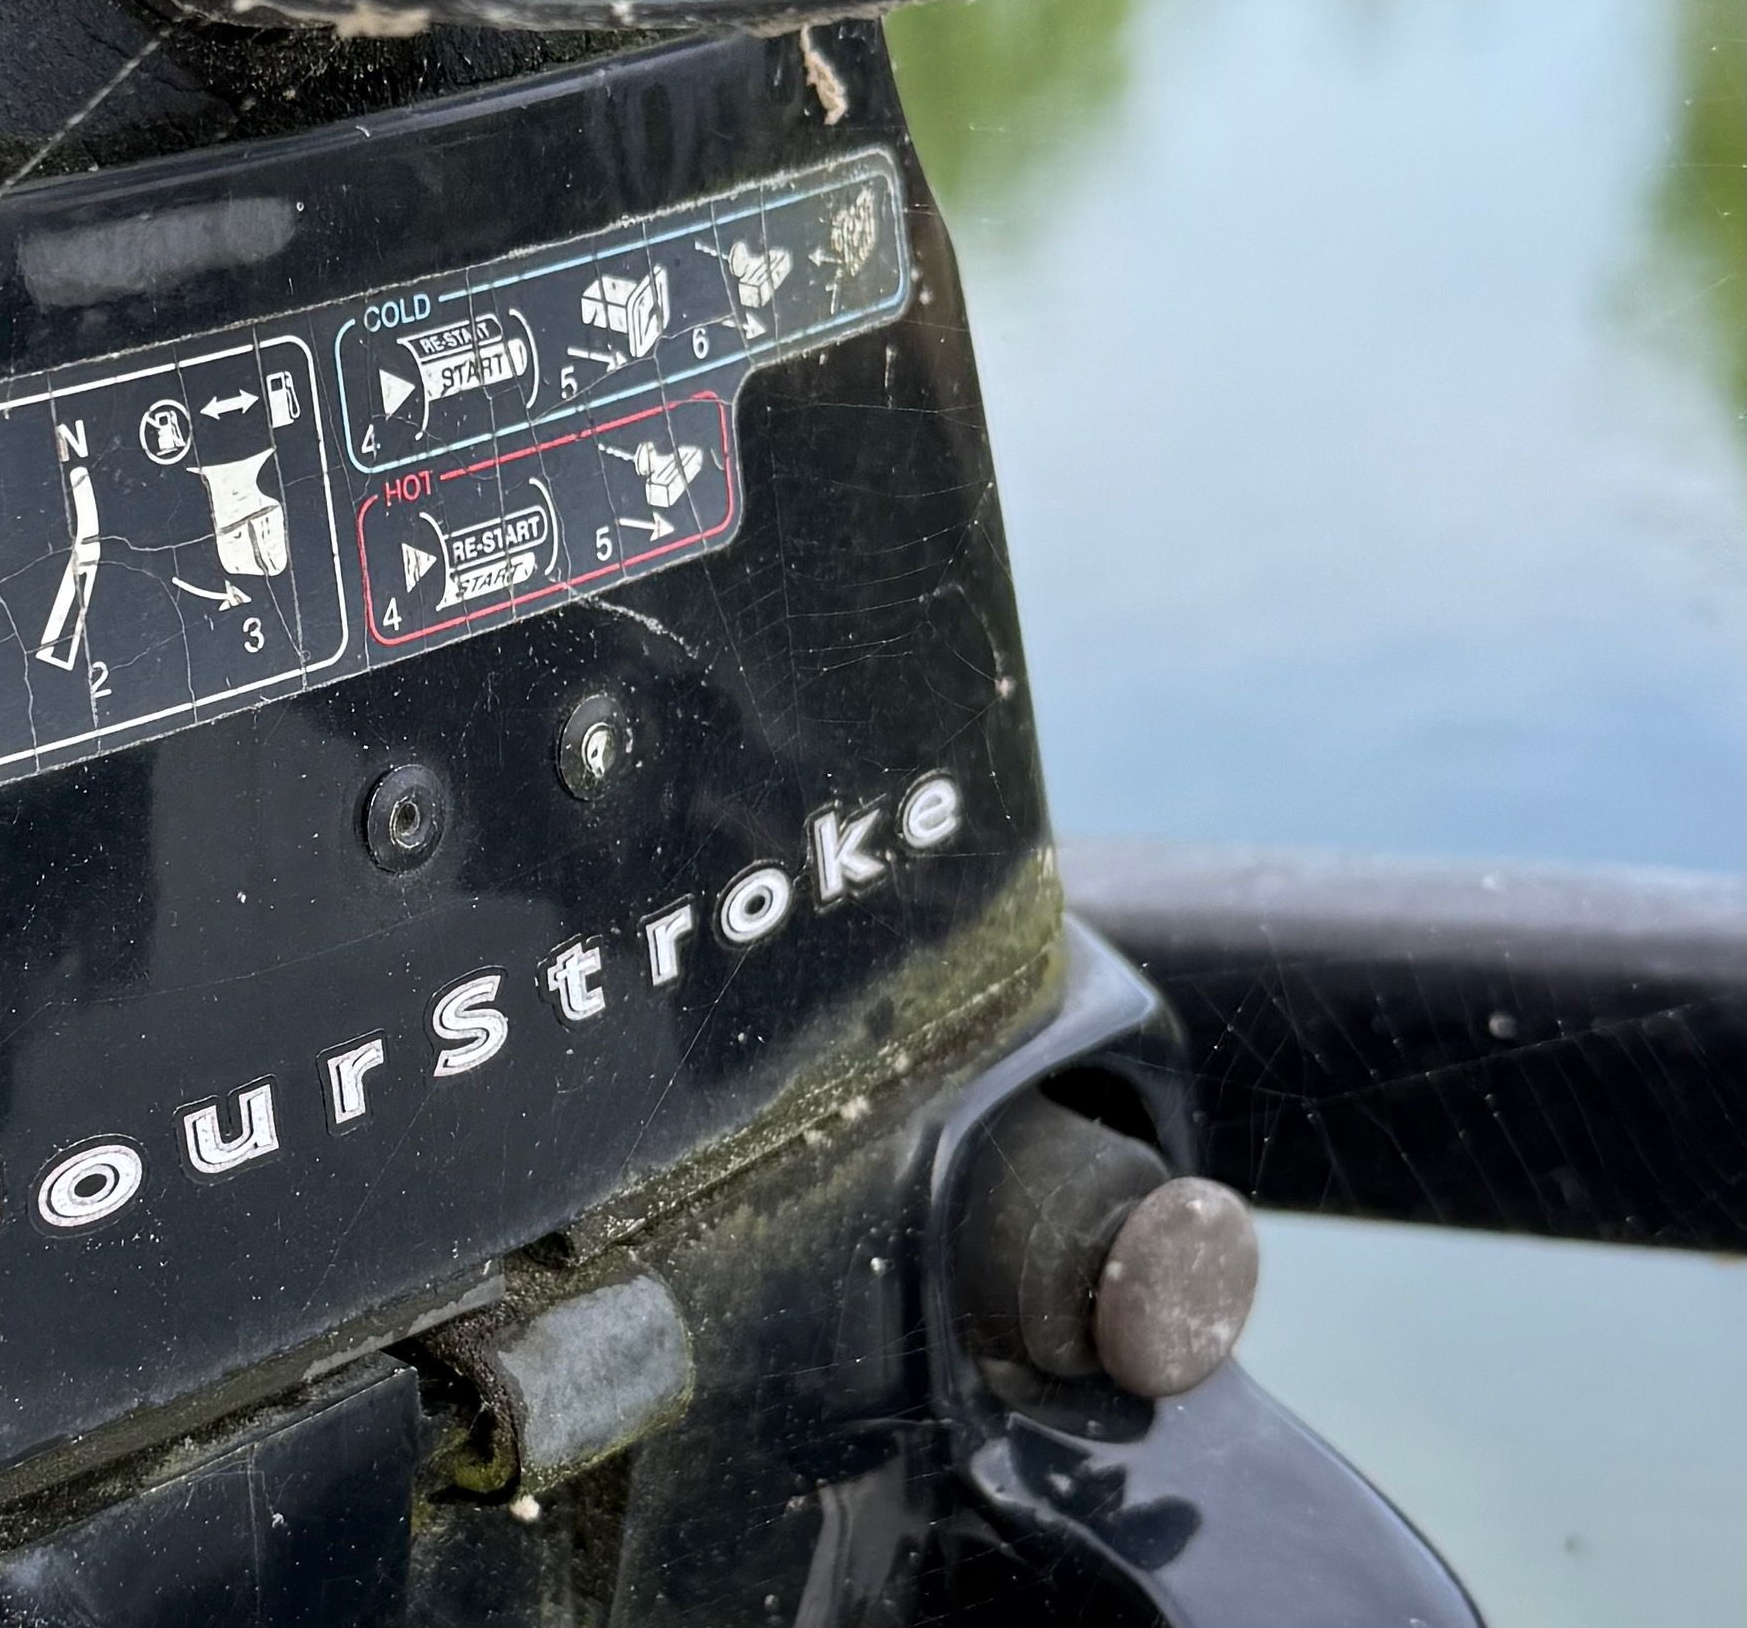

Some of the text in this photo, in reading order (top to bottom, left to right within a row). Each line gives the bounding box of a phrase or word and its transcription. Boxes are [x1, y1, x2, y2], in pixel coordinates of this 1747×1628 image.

[363, 293, 431, 332] COLD
[419, 321, 490, 354] RE-START
[691, 327, 710, 360] 6
[440, 353, 504, 390] START
[559, 365, 578, 399] 5
[56, 419, 89, 462] N
[361, 424, 380, 455] 4
[384, 470, 433, 504] HOT
[452, 516, 541, 562] RE-START
[595, 526, 613, 561] 5
[458, 561, 525, 595] START
[382, 597, 403, 631] 4
[242, 617, 265, 653] 3
[90, 661, 112, 699] 2
